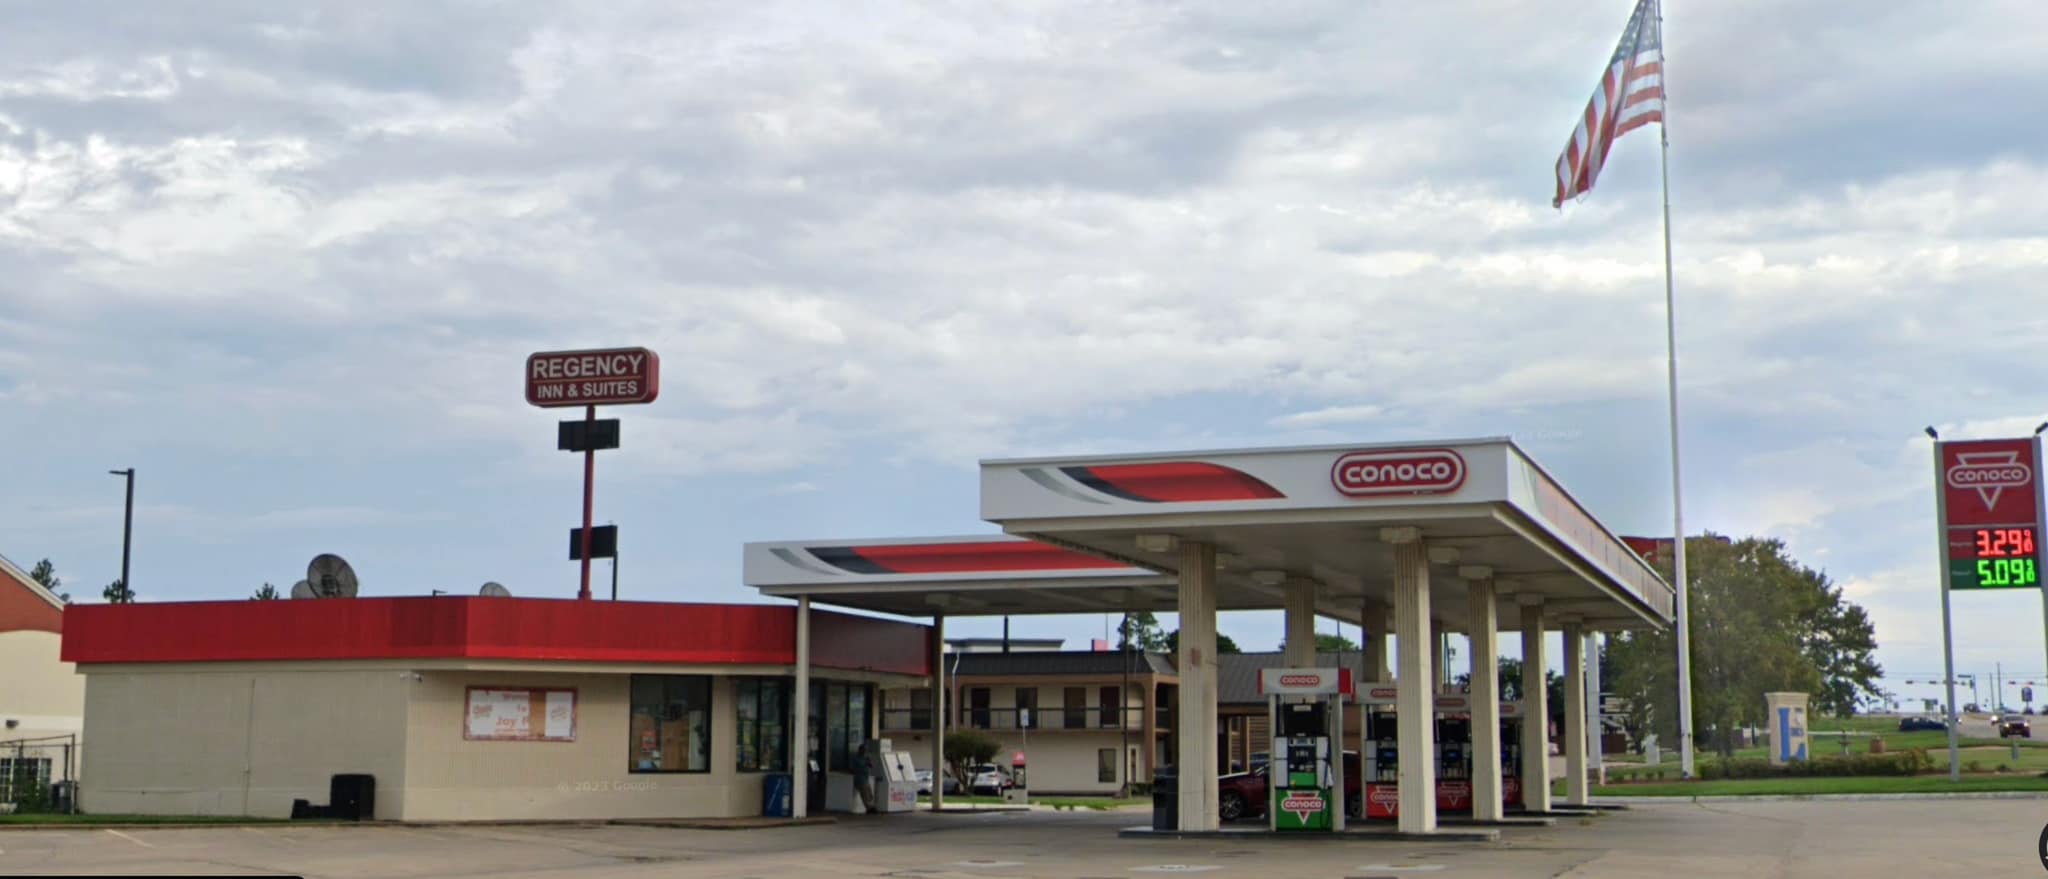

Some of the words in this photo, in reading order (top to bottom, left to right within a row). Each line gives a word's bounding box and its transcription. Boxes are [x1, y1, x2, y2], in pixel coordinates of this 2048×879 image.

[533, 354, 643, 379] REGENCY
[538, 384, 563, 399] INN
[568, 384, 578, 398] &
[582, 380, 638, 397] SUITES
